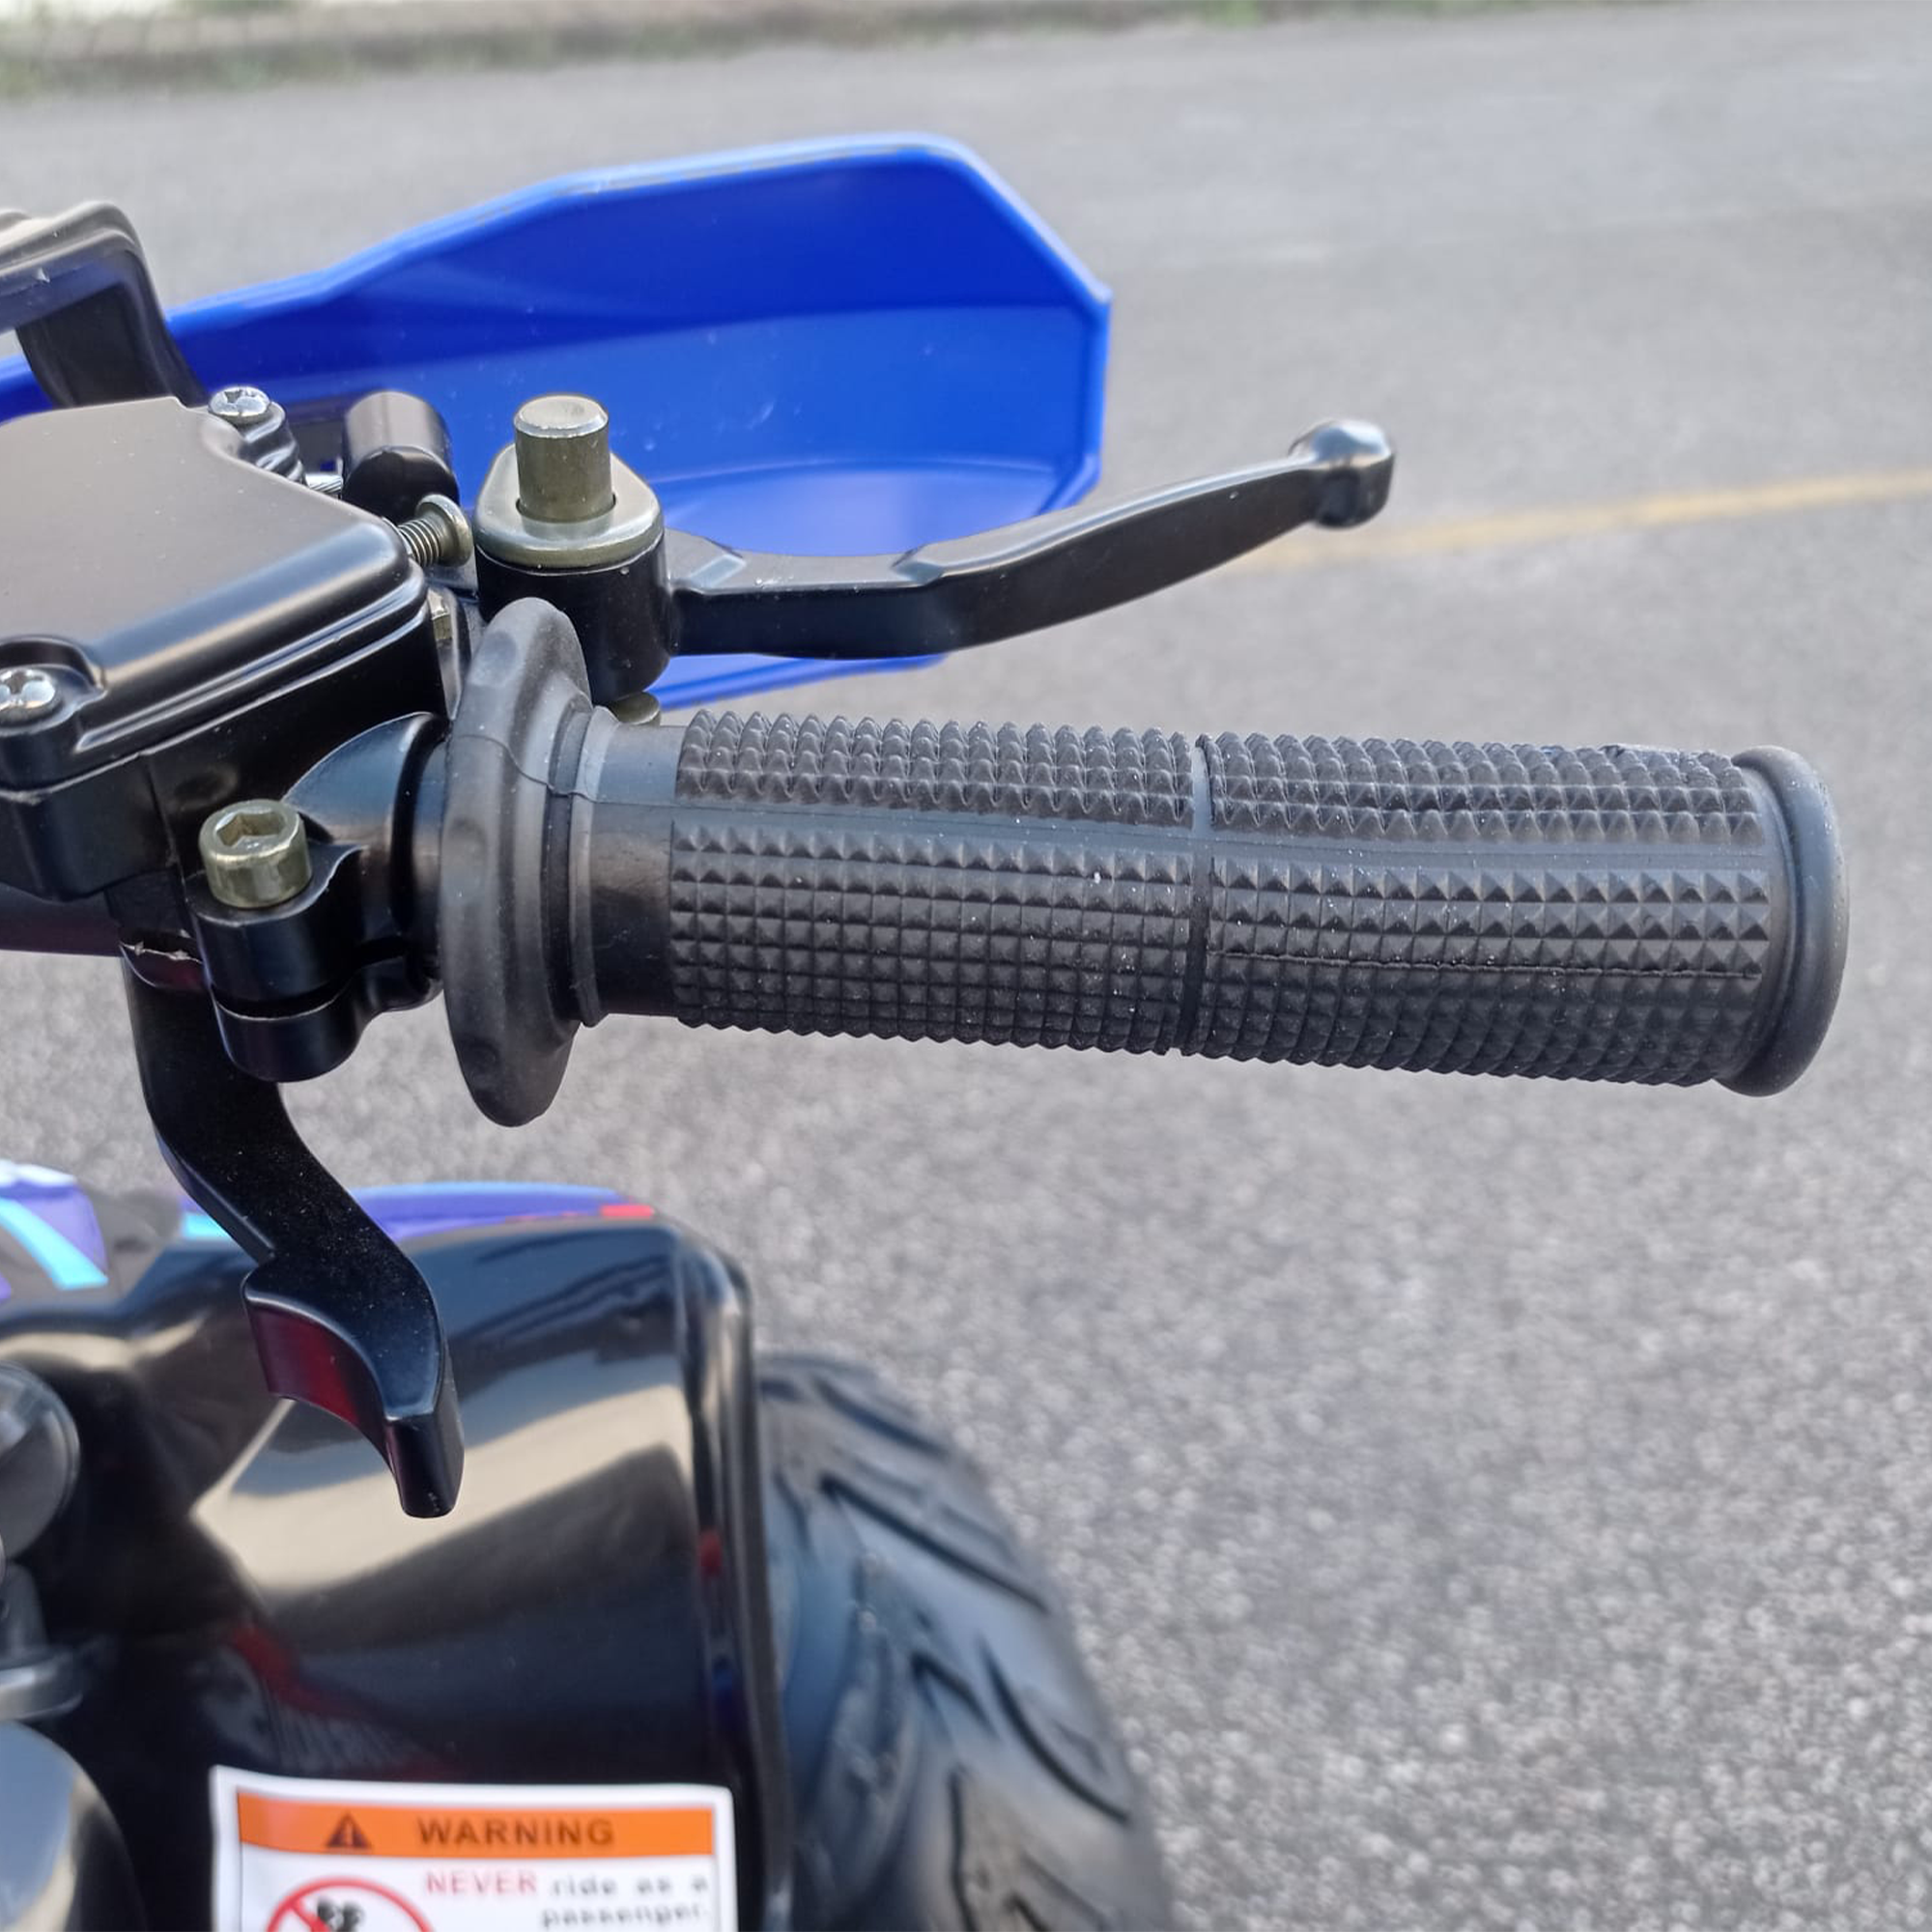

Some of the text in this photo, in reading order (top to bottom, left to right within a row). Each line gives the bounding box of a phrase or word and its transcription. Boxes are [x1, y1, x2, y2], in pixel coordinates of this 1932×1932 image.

[417, 1817, 615, 1846] WARNING
[425, 1870, 537, 1894] NEVER
[552, 1874, 617, 1896] ride
